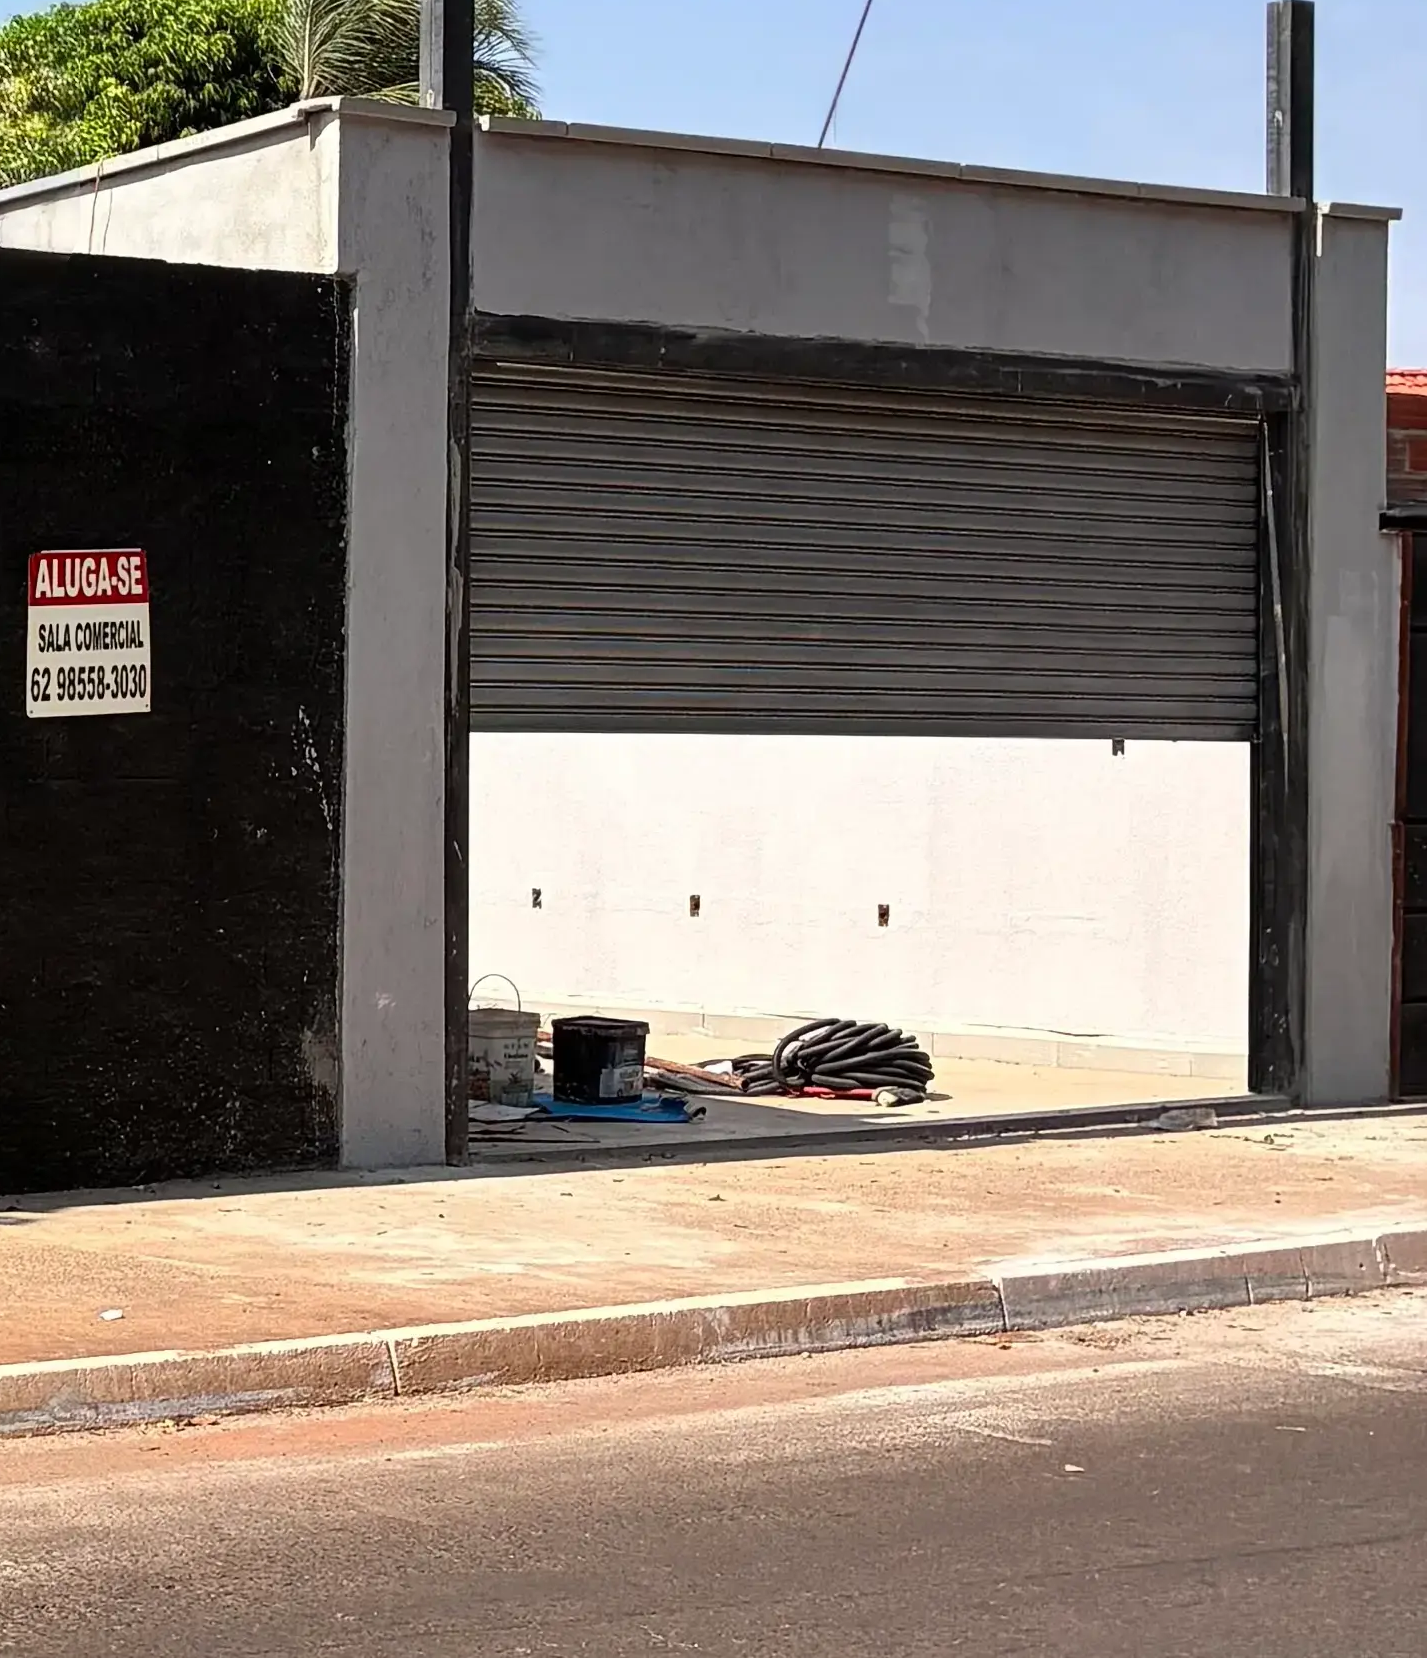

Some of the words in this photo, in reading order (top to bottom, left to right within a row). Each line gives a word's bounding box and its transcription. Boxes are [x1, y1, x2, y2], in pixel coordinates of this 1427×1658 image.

[35, 556, 143, 598] ALUGA-SE
[38, 623, 71, 653] SALA
[75, 620, 144, 651] COMERCIAL
[31, 667, 51, 702] 62
[57, 664, 147, 701] 98558-3030
